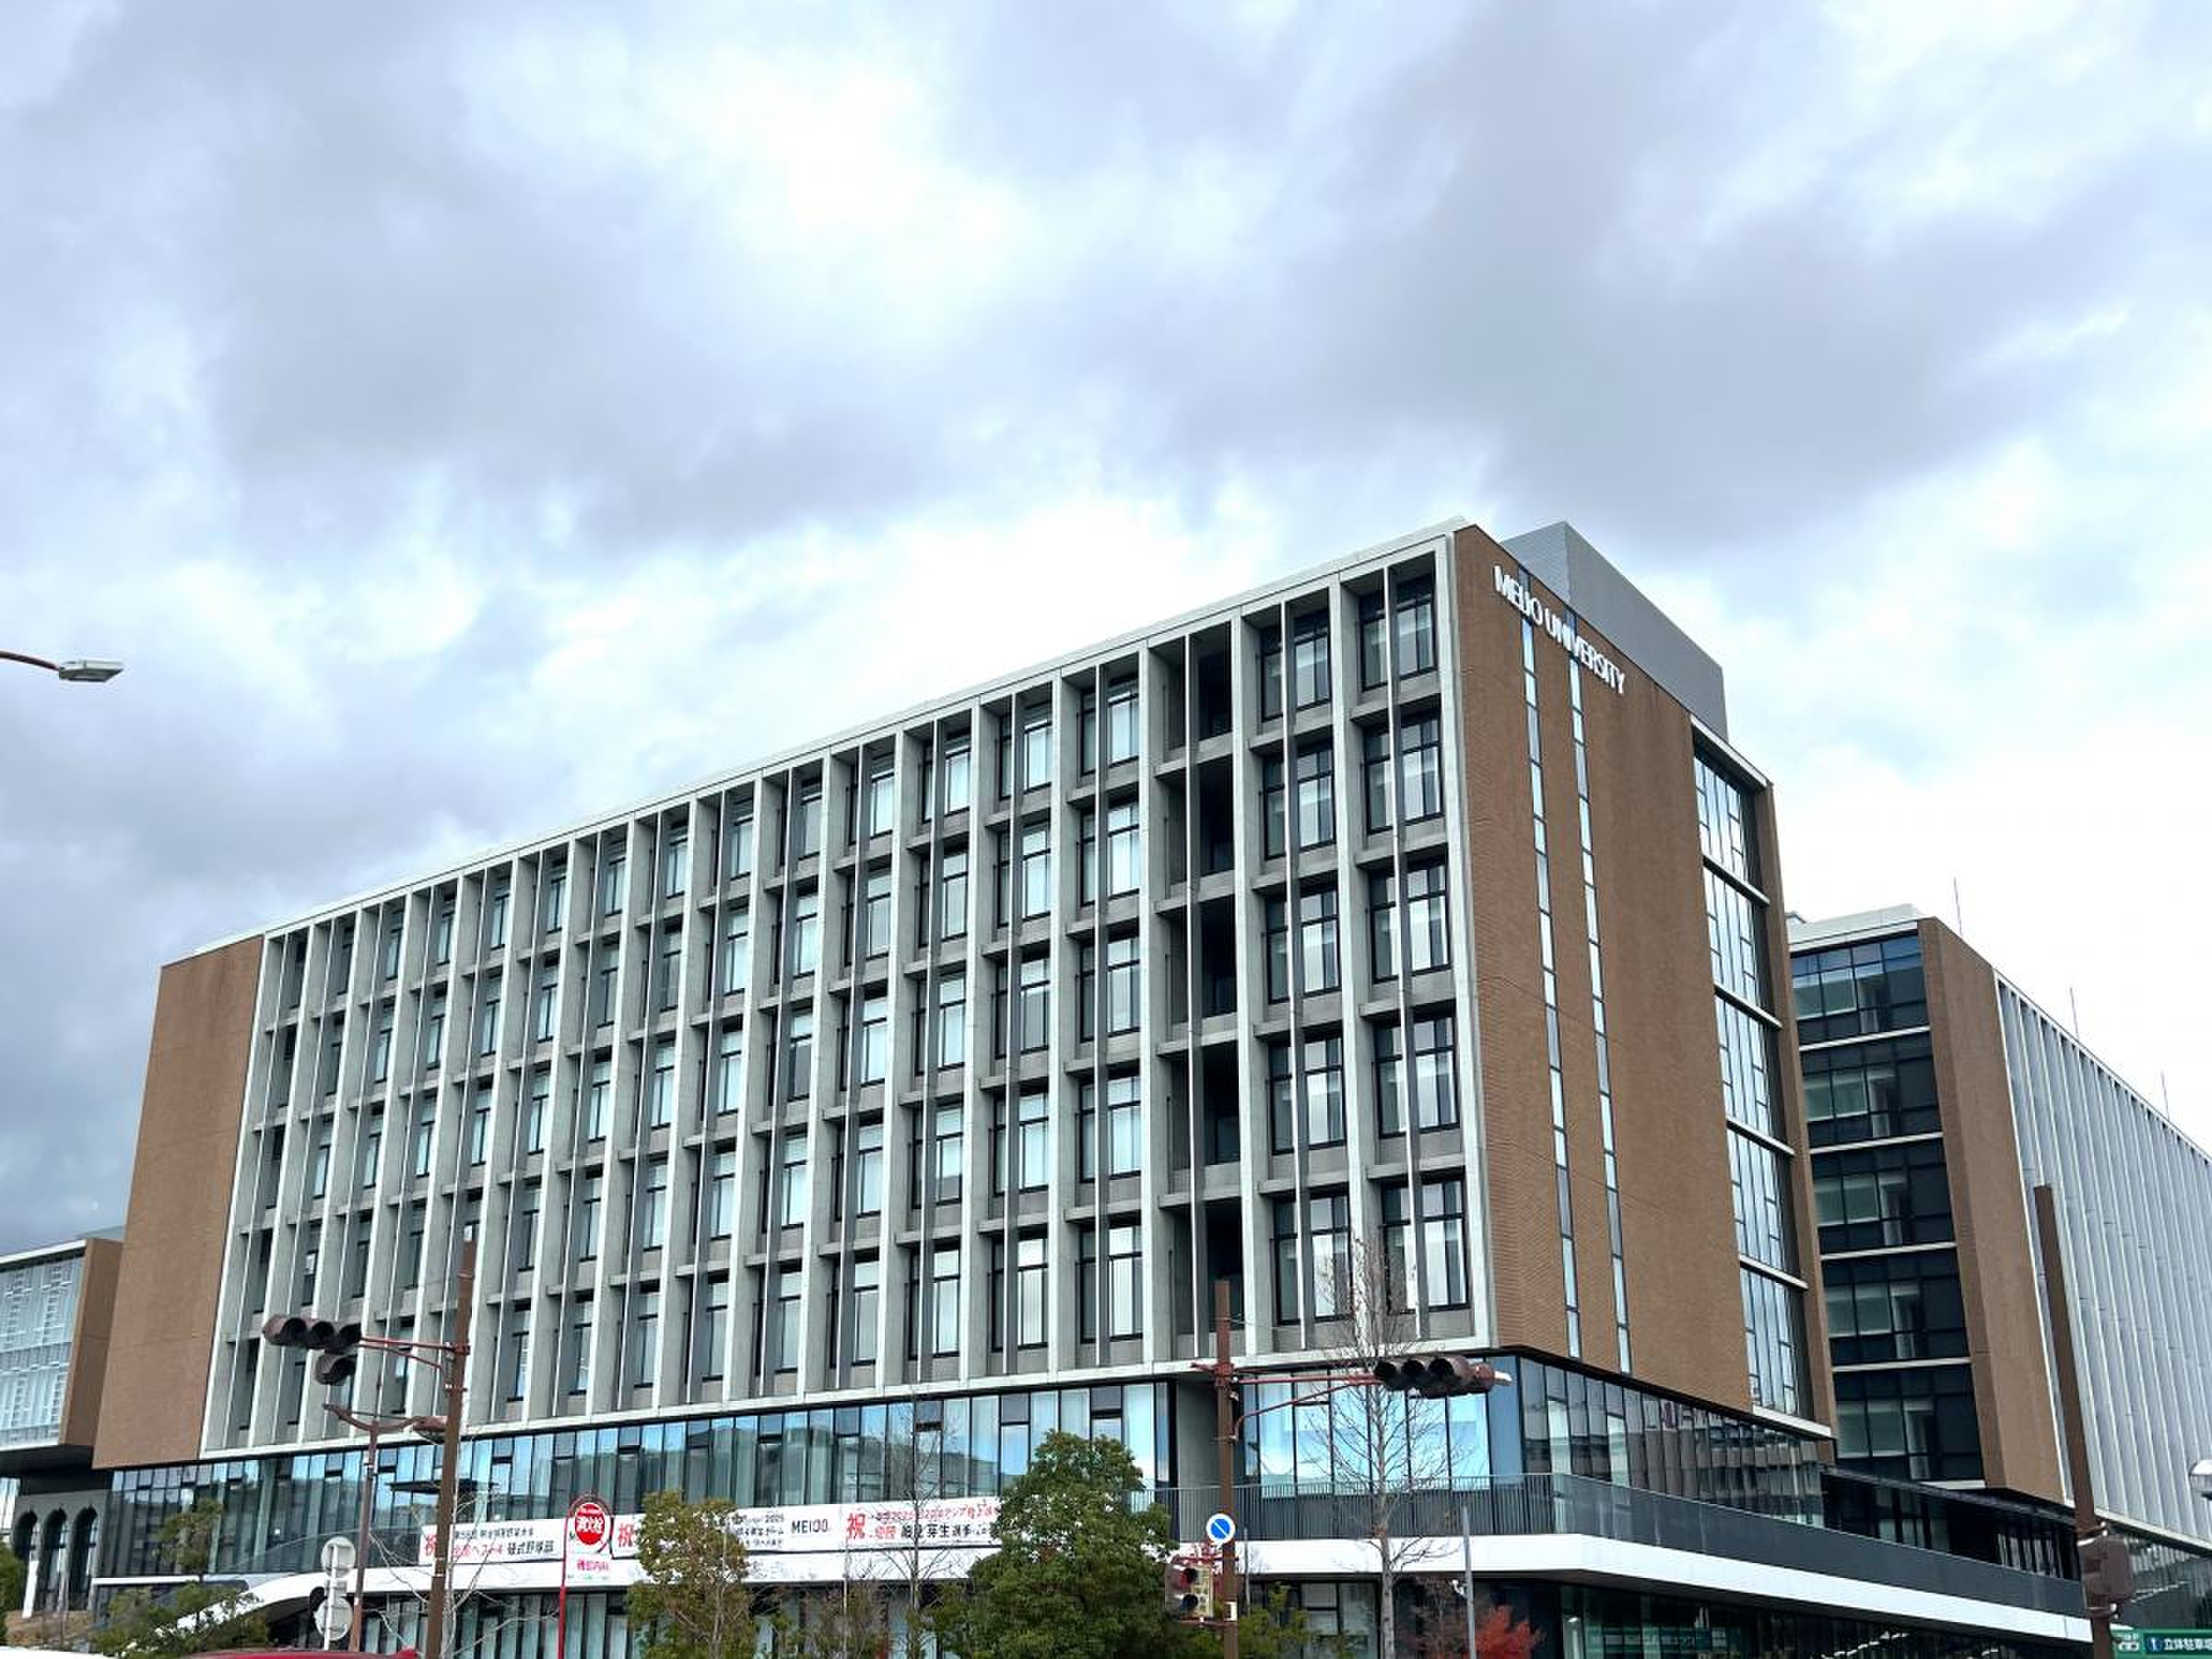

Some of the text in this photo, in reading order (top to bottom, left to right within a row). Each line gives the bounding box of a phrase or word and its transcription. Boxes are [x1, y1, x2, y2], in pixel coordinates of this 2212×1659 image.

[1494, 565, 1626, 694] MEIJO UNIVERSITY
[618, 1523, 634, 1547] 祝
[848, 1512, 865, 1539] 祝
